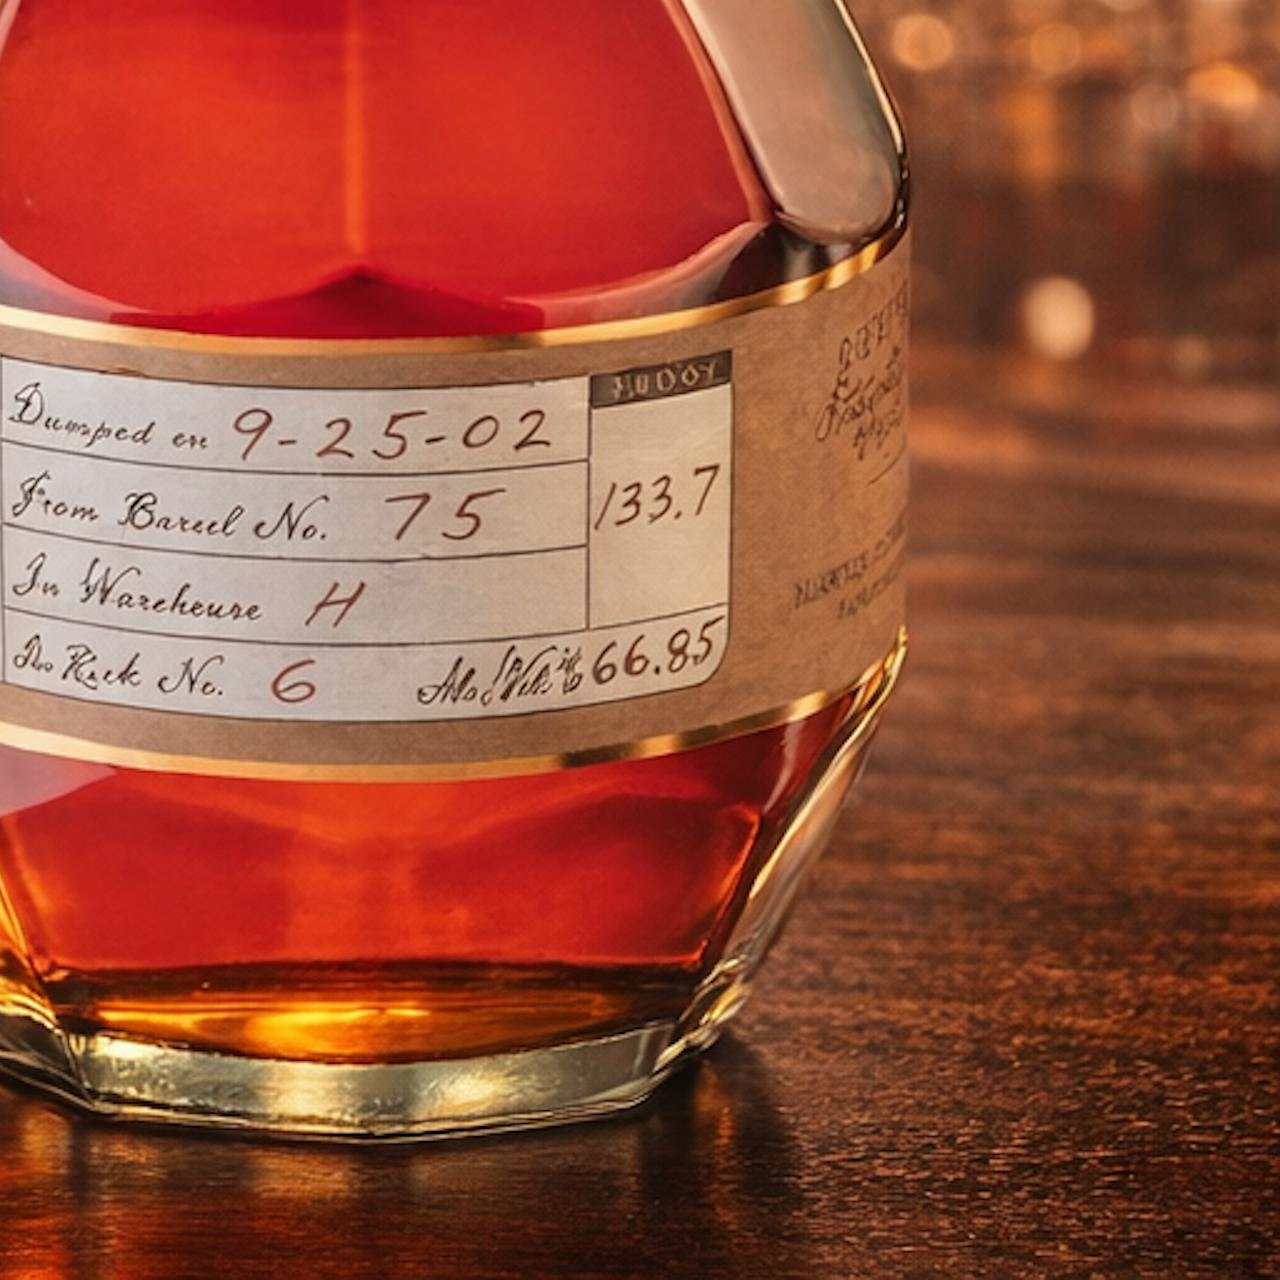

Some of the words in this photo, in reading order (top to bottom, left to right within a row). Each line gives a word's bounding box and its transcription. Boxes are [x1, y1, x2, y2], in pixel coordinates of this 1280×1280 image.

[232, 407, 553, 463] 9-25-02
[253, 494, 331, 542] No.
[385, 487, 507, 541] 75
[592, 463, 722, 532] 133.7
[304, 580, 367, 629] H
[157, 654, 226, 698] No.
[270, 658, 317, 704] 6
[591, 615, 726, 687] 66.85
